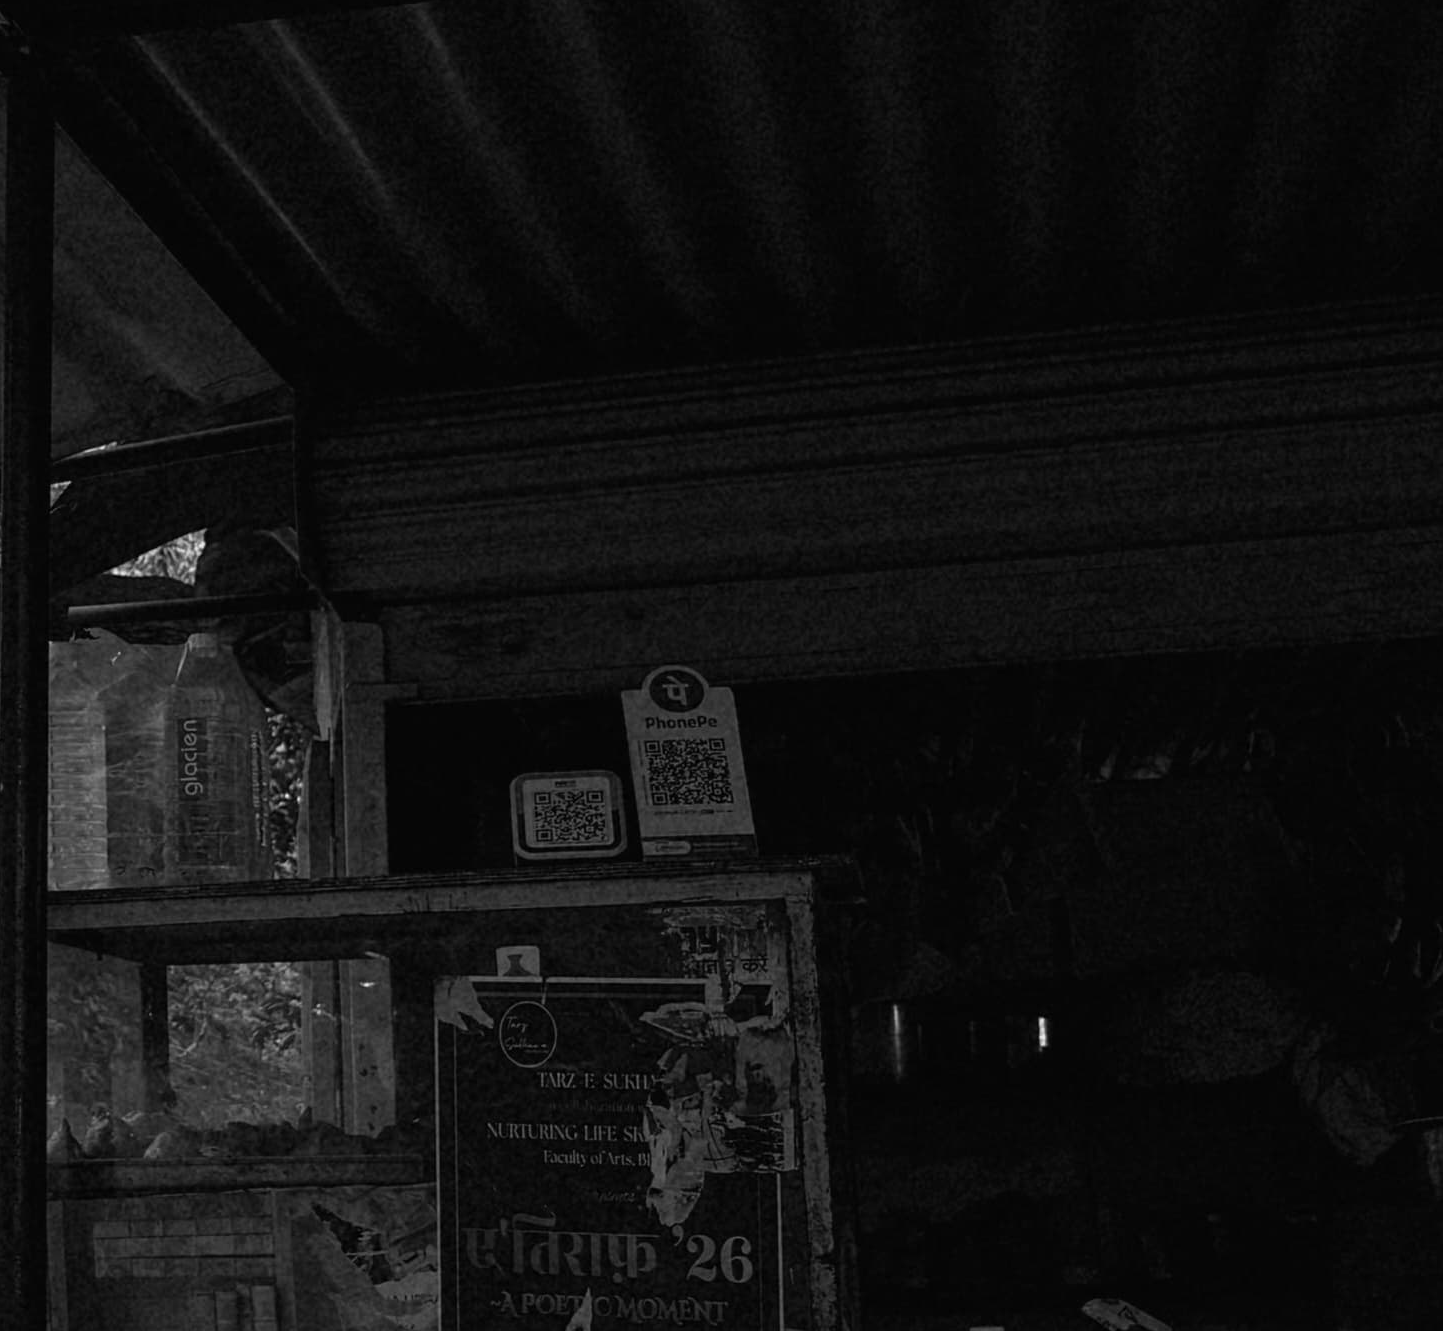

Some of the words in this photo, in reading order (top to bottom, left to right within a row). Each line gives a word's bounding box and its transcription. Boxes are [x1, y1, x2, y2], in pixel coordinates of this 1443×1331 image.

[645, 715, 718, 730] PhonePe
[537, 1071, 577, 1090] TARZ
[486, 1121, 579, 1142] NURTURING
[583, 1124, 618, 1142] LIFE
[542, 1149, 587, 1168] Faculty
[589, 1149, 607, 1166] of
[521, 1292, 611, 1317] POETC
[614, 1294, 729, 1326] MOMENT
